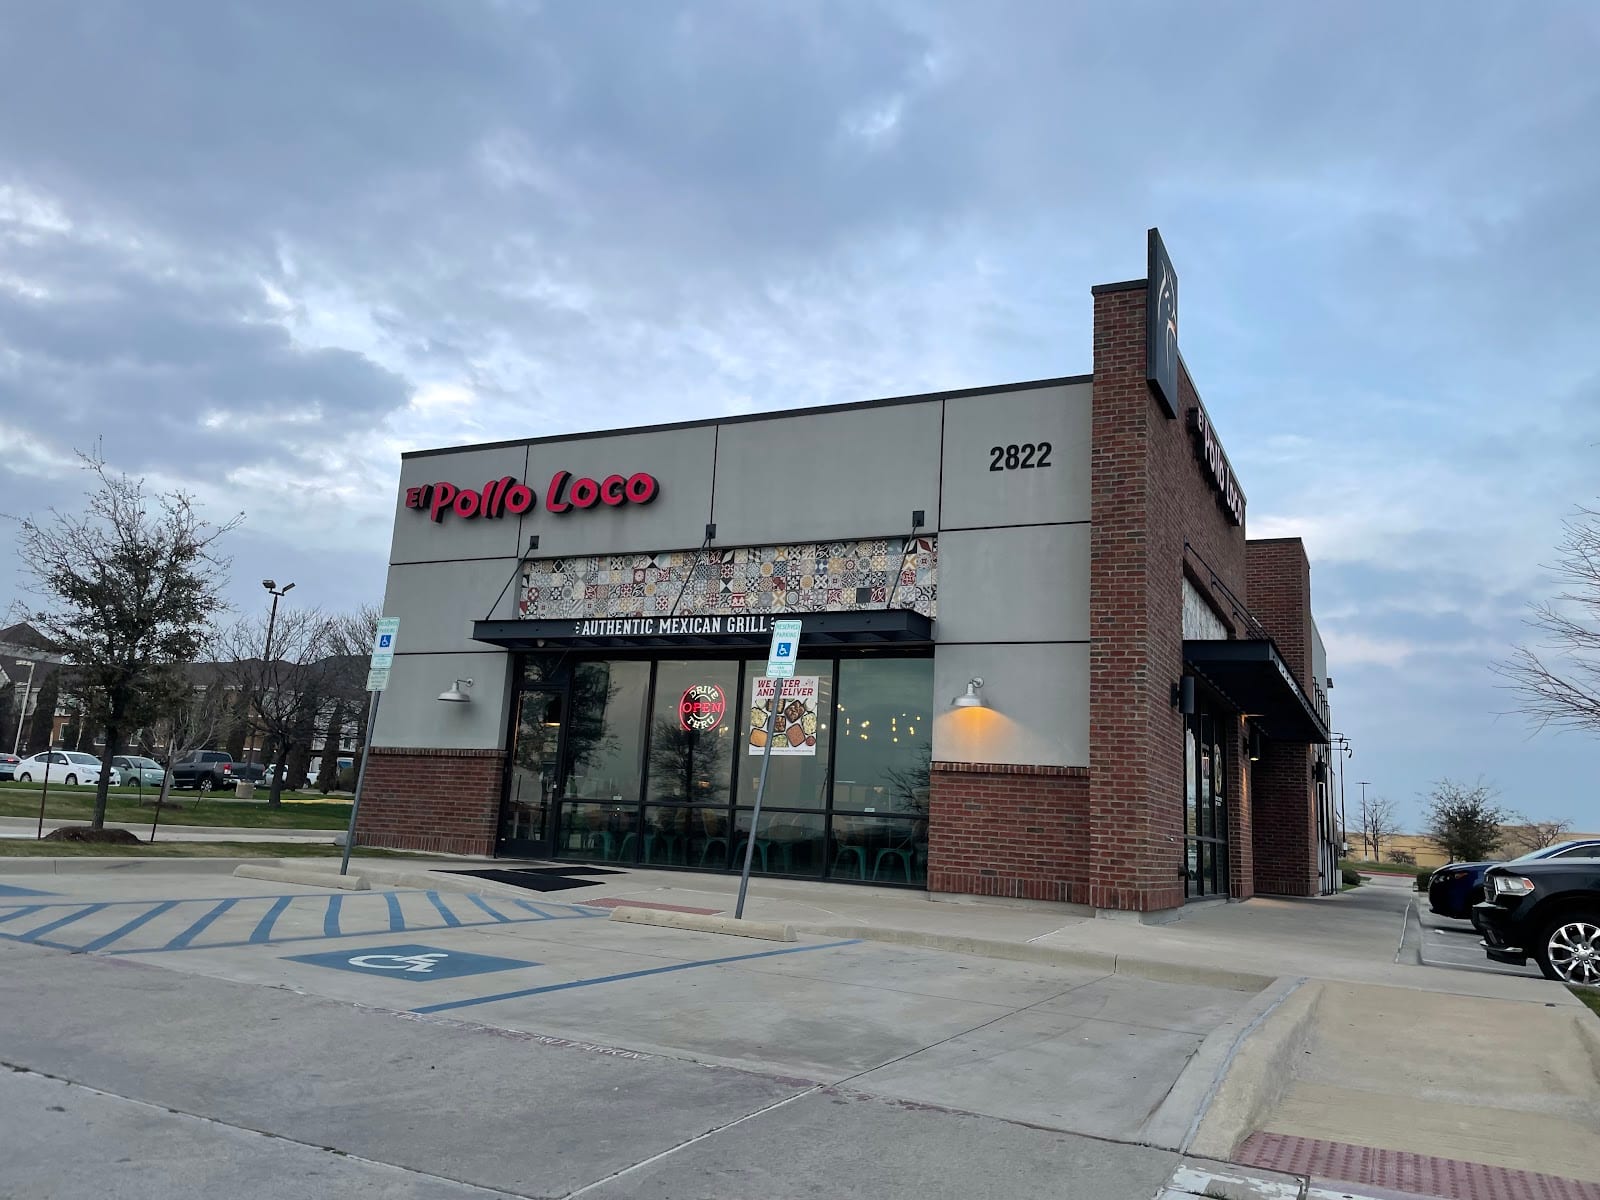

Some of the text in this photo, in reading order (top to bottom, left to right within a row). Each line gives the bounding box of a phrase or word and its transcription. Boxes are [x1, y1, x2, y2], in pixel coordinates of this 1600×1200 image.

[990, 441, 1052, 471] 2822
[406, 470, 660, 524] El Pollo Loco
[581, 615, 767, 636] AUTHENTIC MEXICAN GRILL
[758, 680, 801, 688] WE CTER
[689, 685, 719, 700] DRIVE
[756, 688, 775, 697] AND
[682, 702, 722, 713] OPEN
[687, 715, 715, 730] THRU
